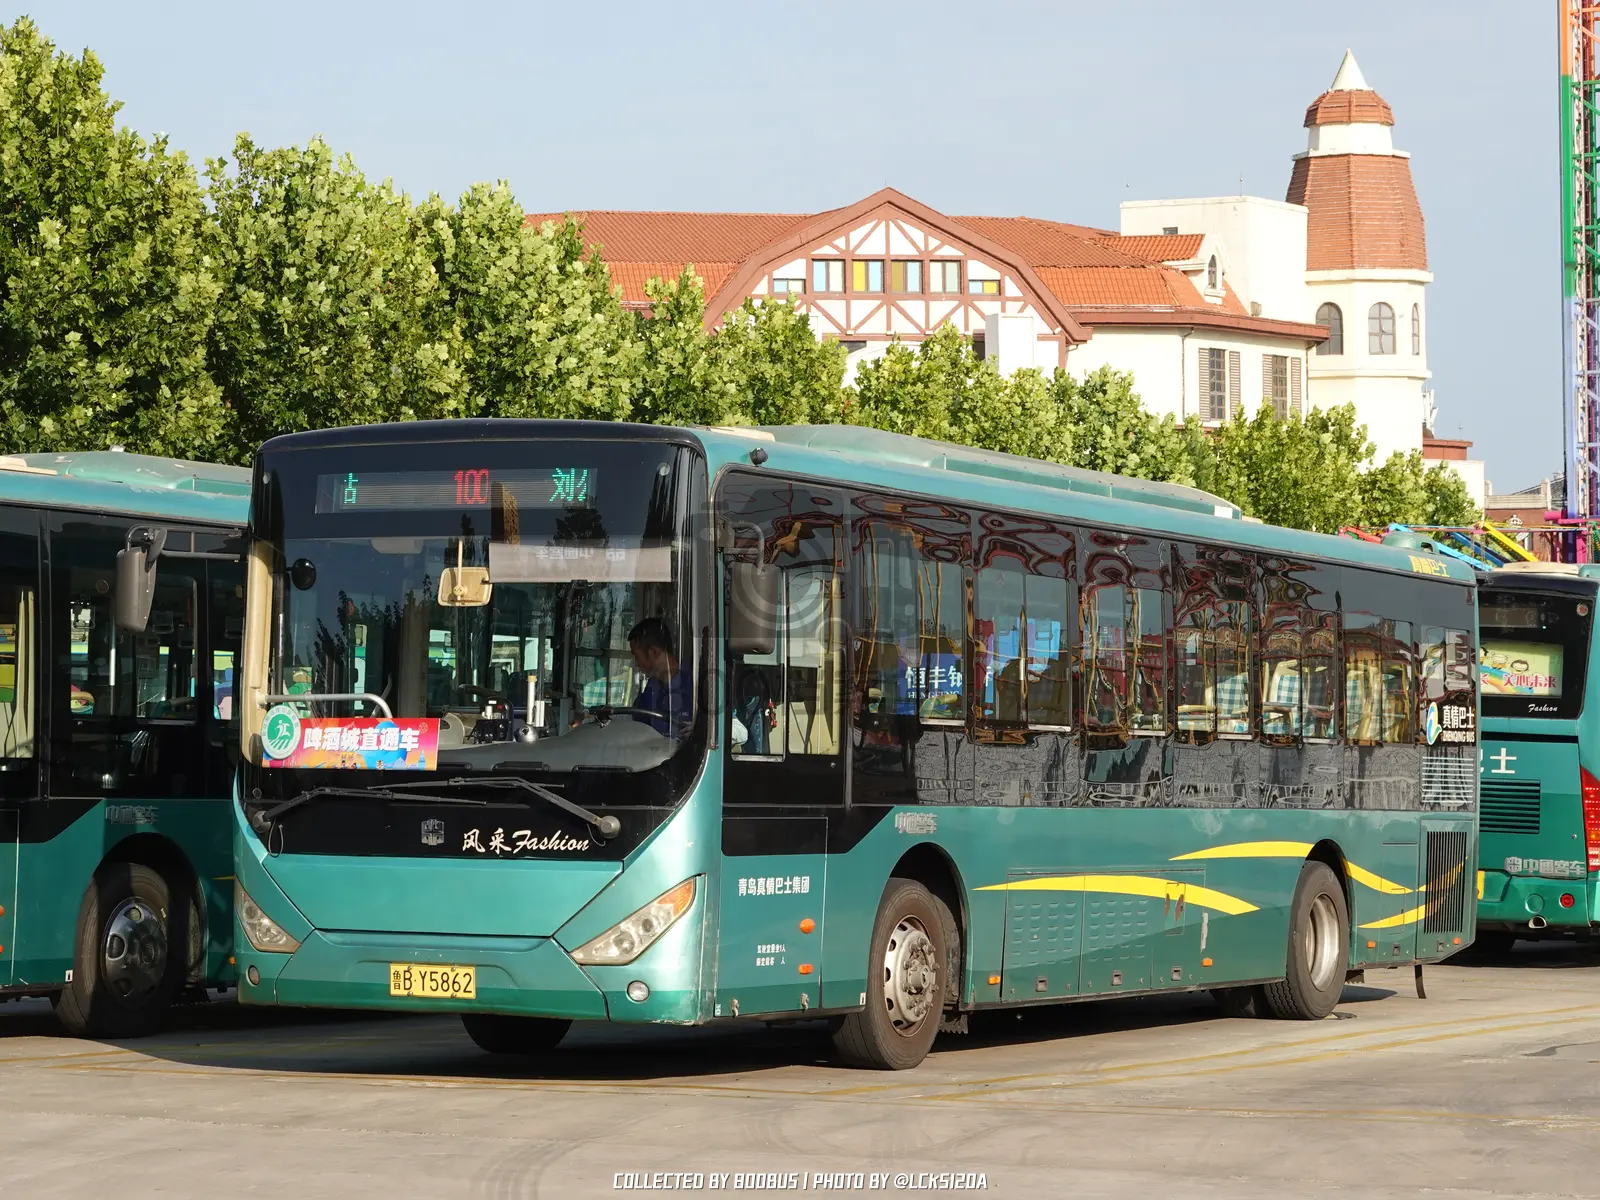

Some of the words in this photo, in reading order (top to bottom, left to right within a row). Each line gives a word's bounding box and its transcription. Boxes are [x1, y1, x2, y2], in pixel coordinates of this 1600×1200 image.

[454, 469, 489, 504] 100
[1442, 705, 1475, 729] 真情巴士
[1527, 703, 1558, 713] Fashion
[302, 726, 421, 752] 啤酒城直通车
[462, 828, 512, 855] 风采
[511, 829, 590, 854] Fashion
[1522, 858, 1586, 876] 中通客车
[738, 875, 810, 897] 青岛真情巴士集团
